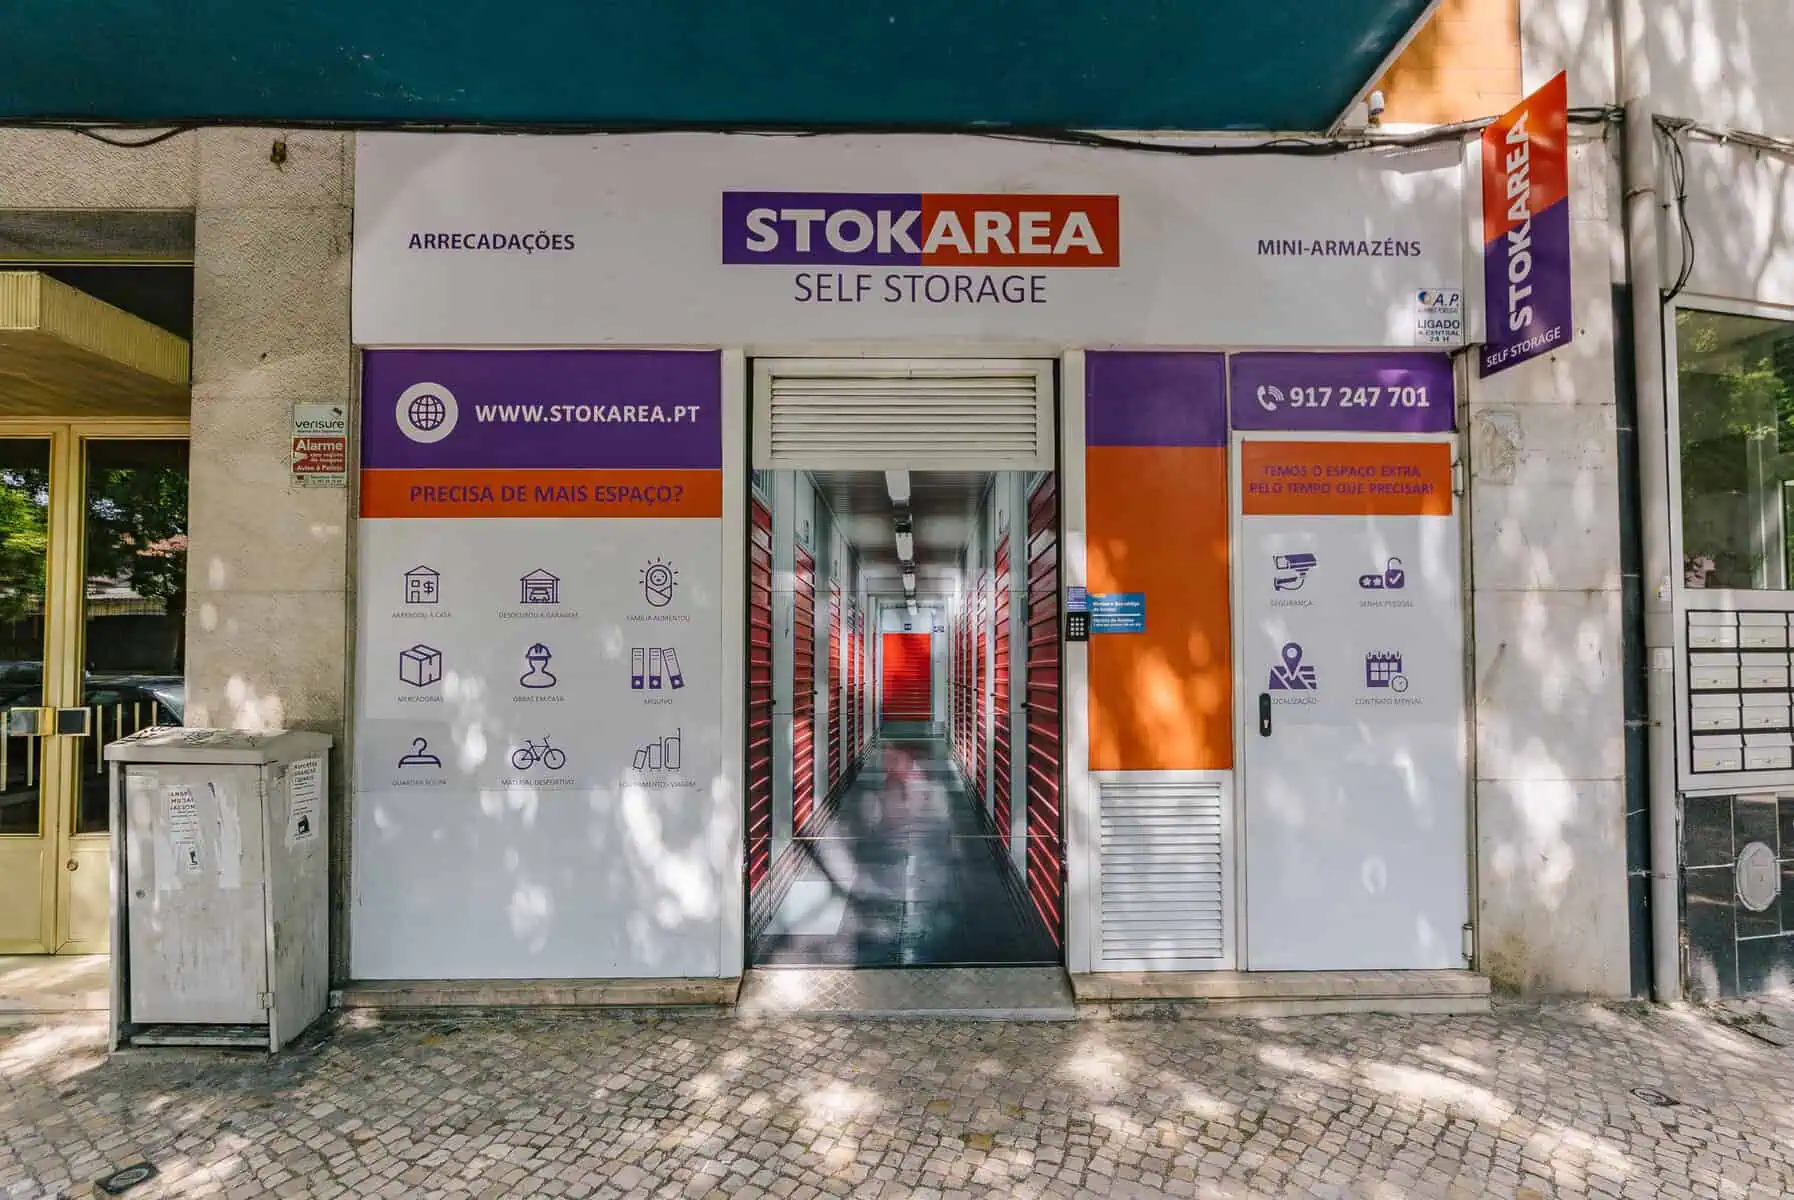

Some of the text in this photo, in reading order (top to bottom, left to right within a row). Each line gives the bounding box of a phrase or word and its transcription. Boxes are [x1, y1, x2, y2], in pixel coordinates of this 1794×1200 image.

[745, 208, 1104, 255] STOKAREA
[1507, 112, 1532, 331] STOKAREA
[408, 231, 576, 254] ARRECADAÇÕES
[1257, 238, 1421, 257] MINI-ARMAZÉNS
[794, 273, 1048, 304] SELF STORAGE
[1417, 319, 1460, 329] LIGADO
[1486, 326, 1562, 369] SELF STORAGE
[1290, 387, 1430, 407] 917 247 701
[475, 404, 700, 424] WWW.STOKAREA.PT
[295, 420, 345, 429] verisure
[296, 439, 344, 451] Alarme
[1264, 465, 1308, 477] TEMOS
[1313, 466, 1322, 477] O
[1327, 465, 1375, 479] ESPAÇO
[410, 485, 684, 506] PRECISA DE MAIS ESPAÇO?
[1250, 483, 1283, 494] PELO
[1288, 483, 1330, 494] TEMPO
[1336, 483, 1363, 496] QUE
